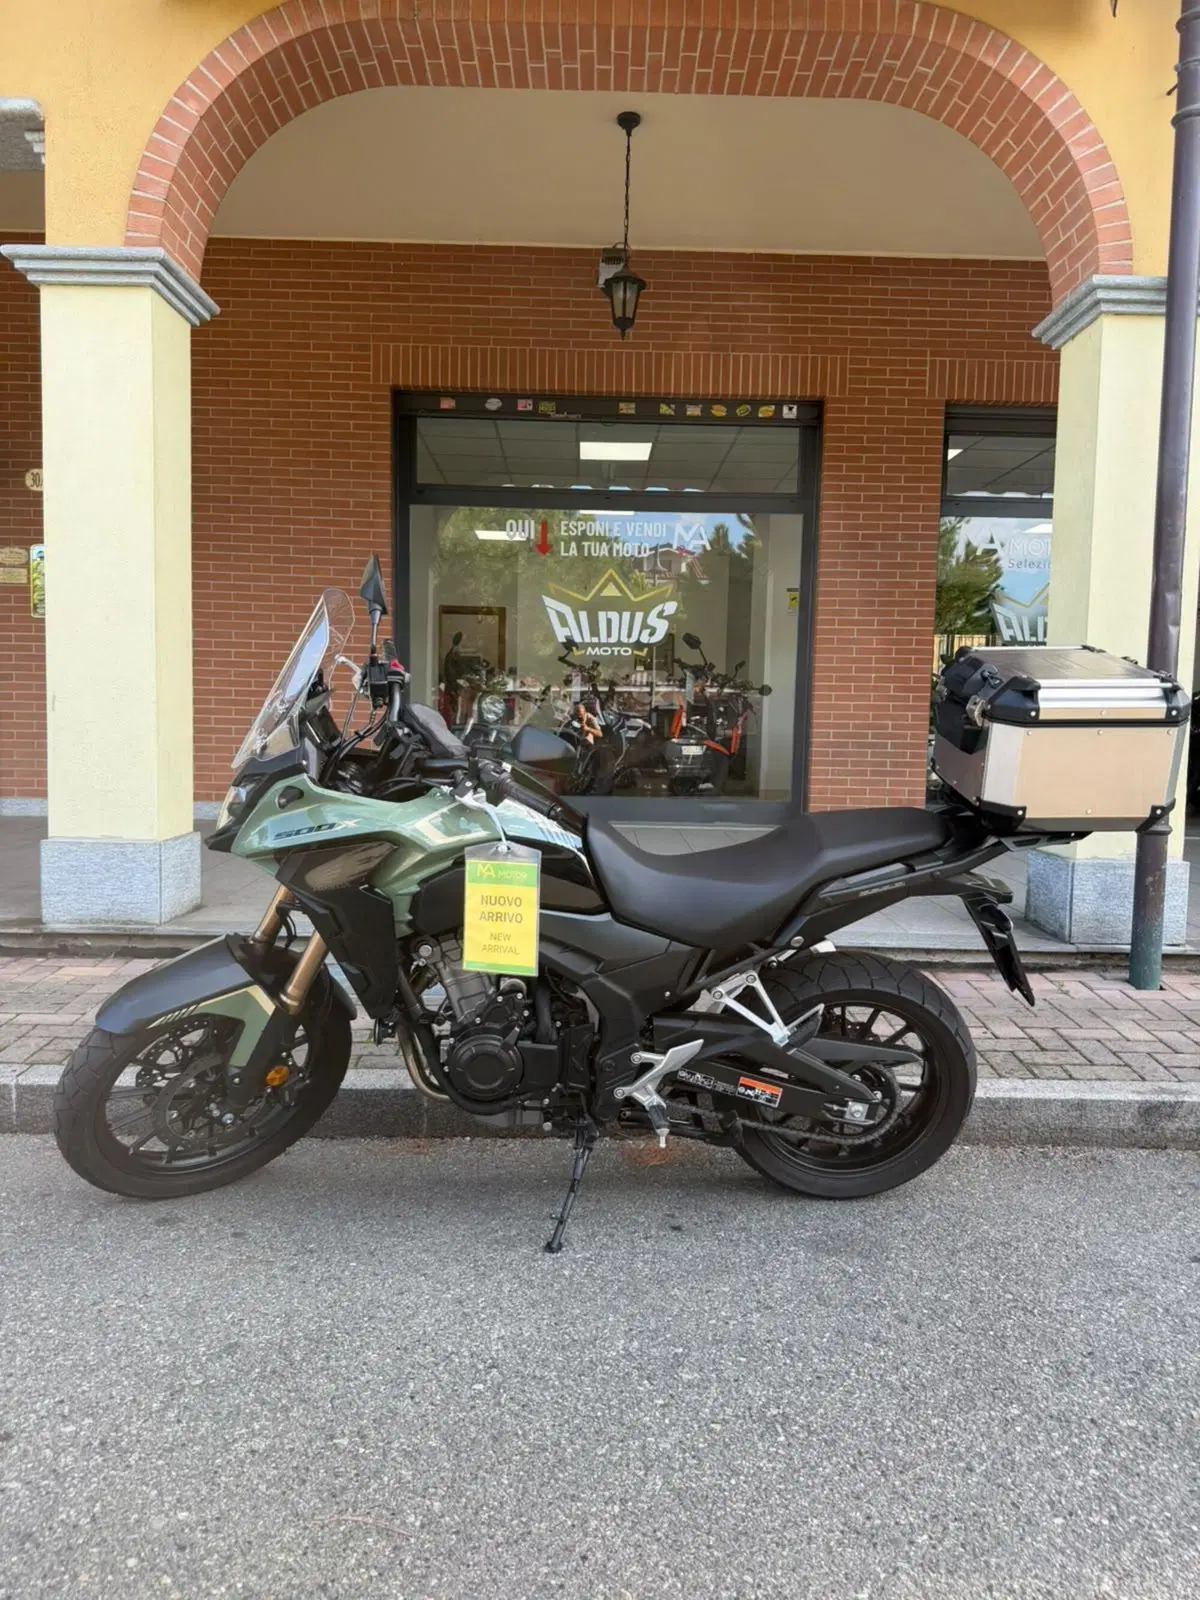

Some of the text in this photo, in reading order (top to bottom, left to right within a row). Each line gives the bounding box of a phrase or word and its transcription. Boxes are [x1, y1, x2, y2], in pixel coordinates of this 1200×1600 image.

[31, 471, 43, 488] 30
[505, 519, 535, 541] QUI
[560, 520, 667, 538] ESPONI E VENDI
[560, 541, 650, 558] LA TUA MOTO
[541, 594, 678, 644] ALDUS
[586, 647, 632, 656] MOTO
[480, 895, 523, 908] NUOVO
[479, 910, 524, 924] ARRIVO
[489, 932, 512, 942] NEW
[481, 944, 520, 956] ARRIVAL
